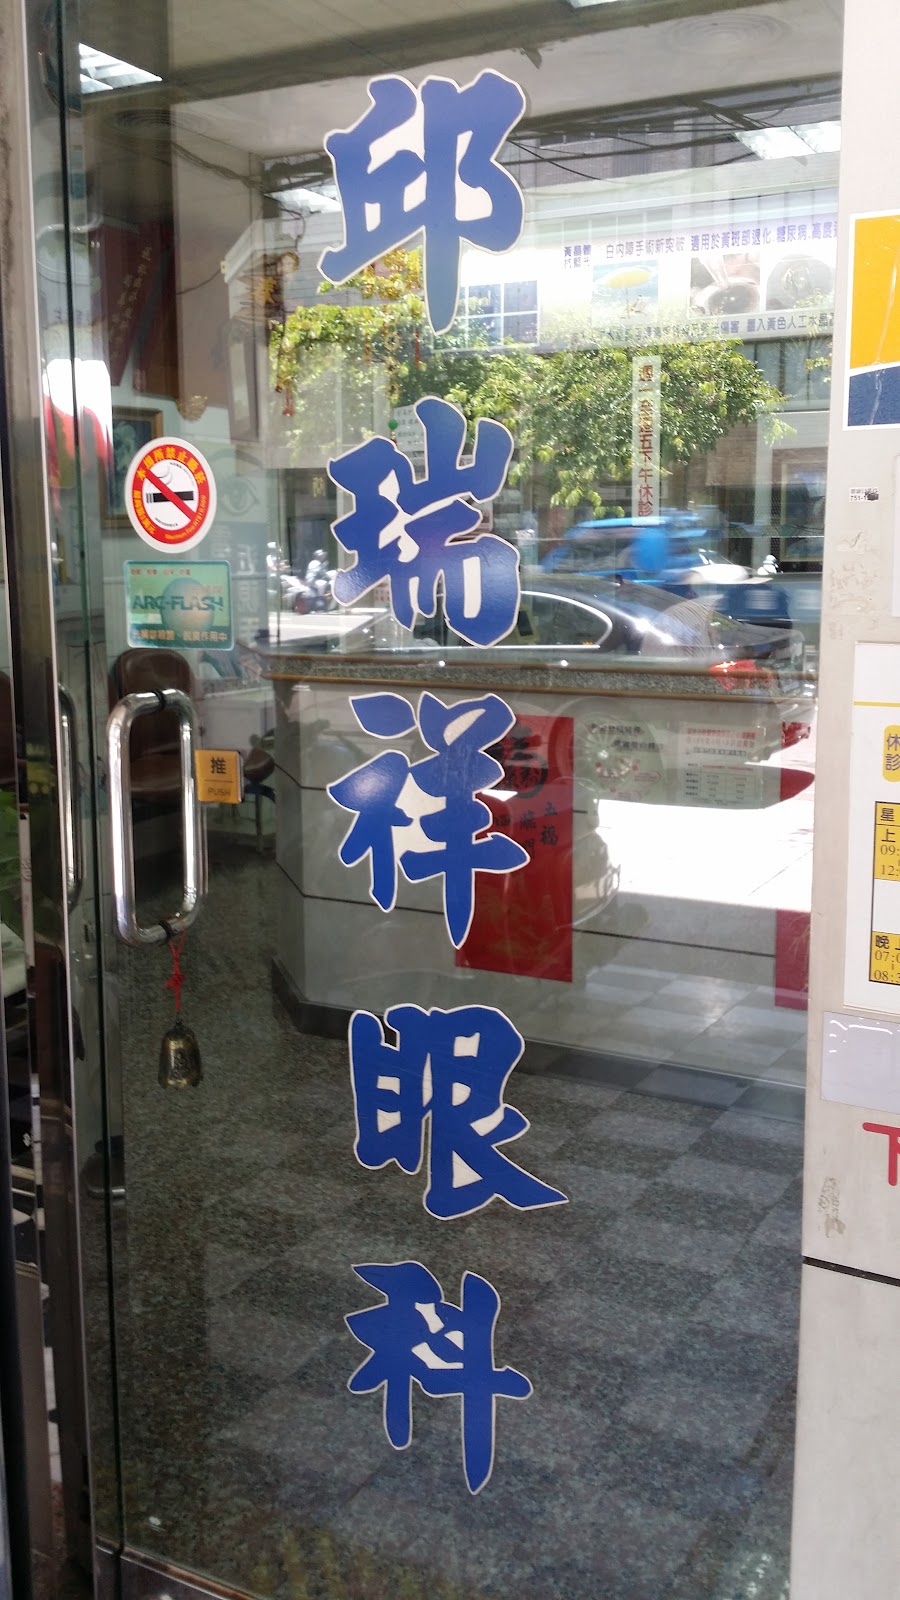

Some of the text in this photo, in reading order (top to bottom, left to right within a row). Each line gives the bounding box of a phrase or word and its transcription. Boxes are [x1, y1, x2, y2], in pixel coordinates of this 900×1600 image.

[132, 595, 224, 612] ARC-FLASH
[885, 733, 900, 771] 休診
[210, 756, 227, 775] 推
[207, 787, 231, 797] PUSH
[319, 69, 567, 1496] 邱瑞祥眼科
